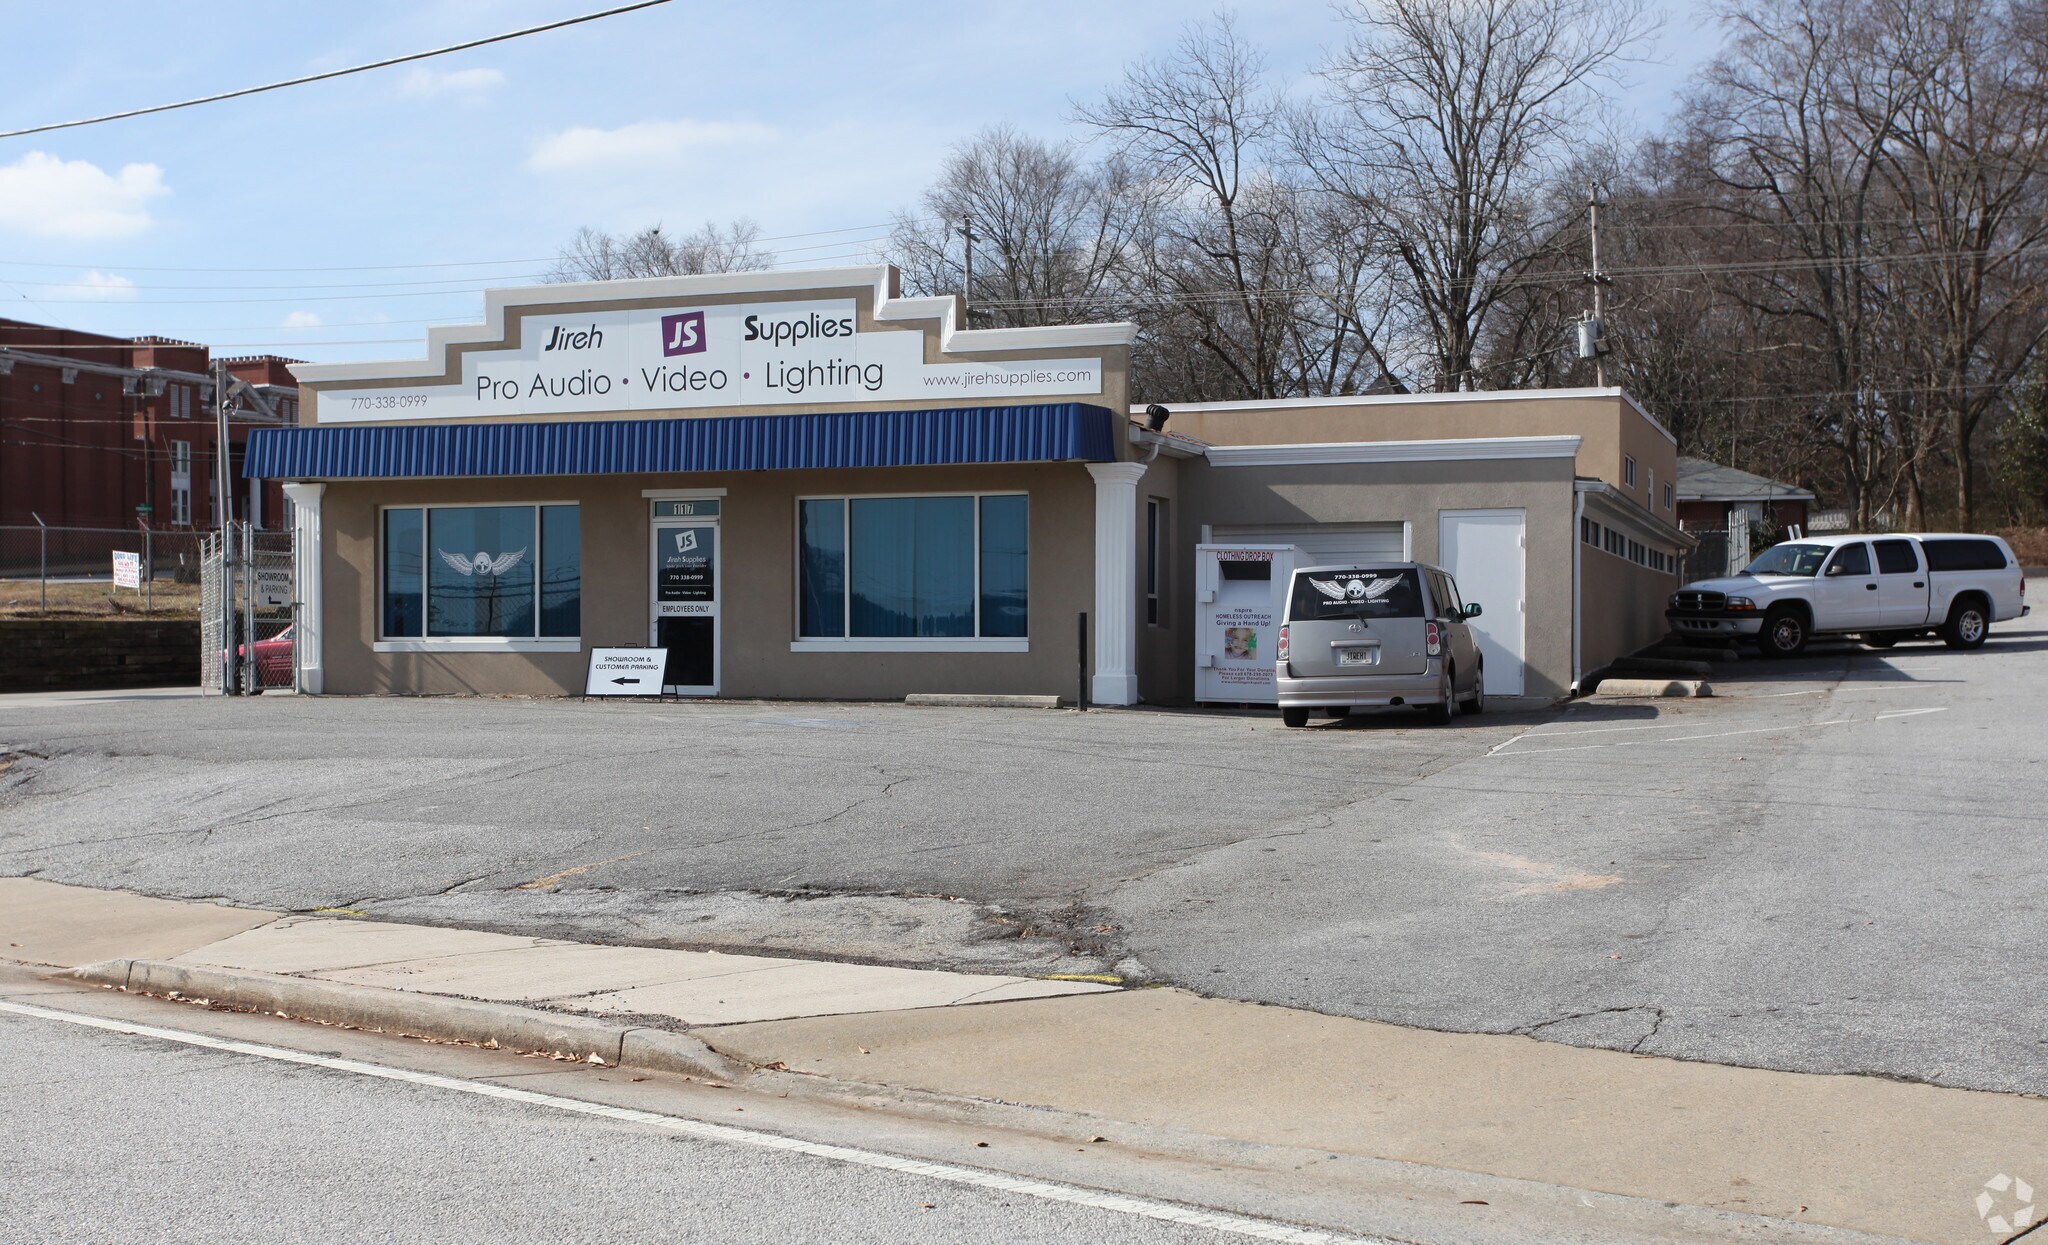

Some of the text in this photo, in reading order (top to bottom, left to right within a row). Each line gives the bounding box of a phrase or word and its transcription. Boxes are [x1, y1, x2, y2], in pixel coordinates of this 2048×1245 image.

[668, 320, 699, 350] JS
[744, 312, 853, 347] Supplies
[545, 324, 603, 351] Jireh
[476, 358, 884, 402] Pro Audio Video Lighting
[923, 369, 1091, 389] www.jirehsupplies.com
[351, 395, 428, 411] 770-338-0999
[674, 503, 693, 515] 117
[680, 534, 693, 549] JS
[682, 556, 707, 564] Supplies
[1216, 551, 1274, 561] CLOTHING DROP BOX
[257, 571, 289, 581] SHOWROOM
[265, 584, 288, 594] PARKING
[662, 605, 710, 613] EMPLOYEES ONLY
[1260, 620, 1271, 628] Up!
